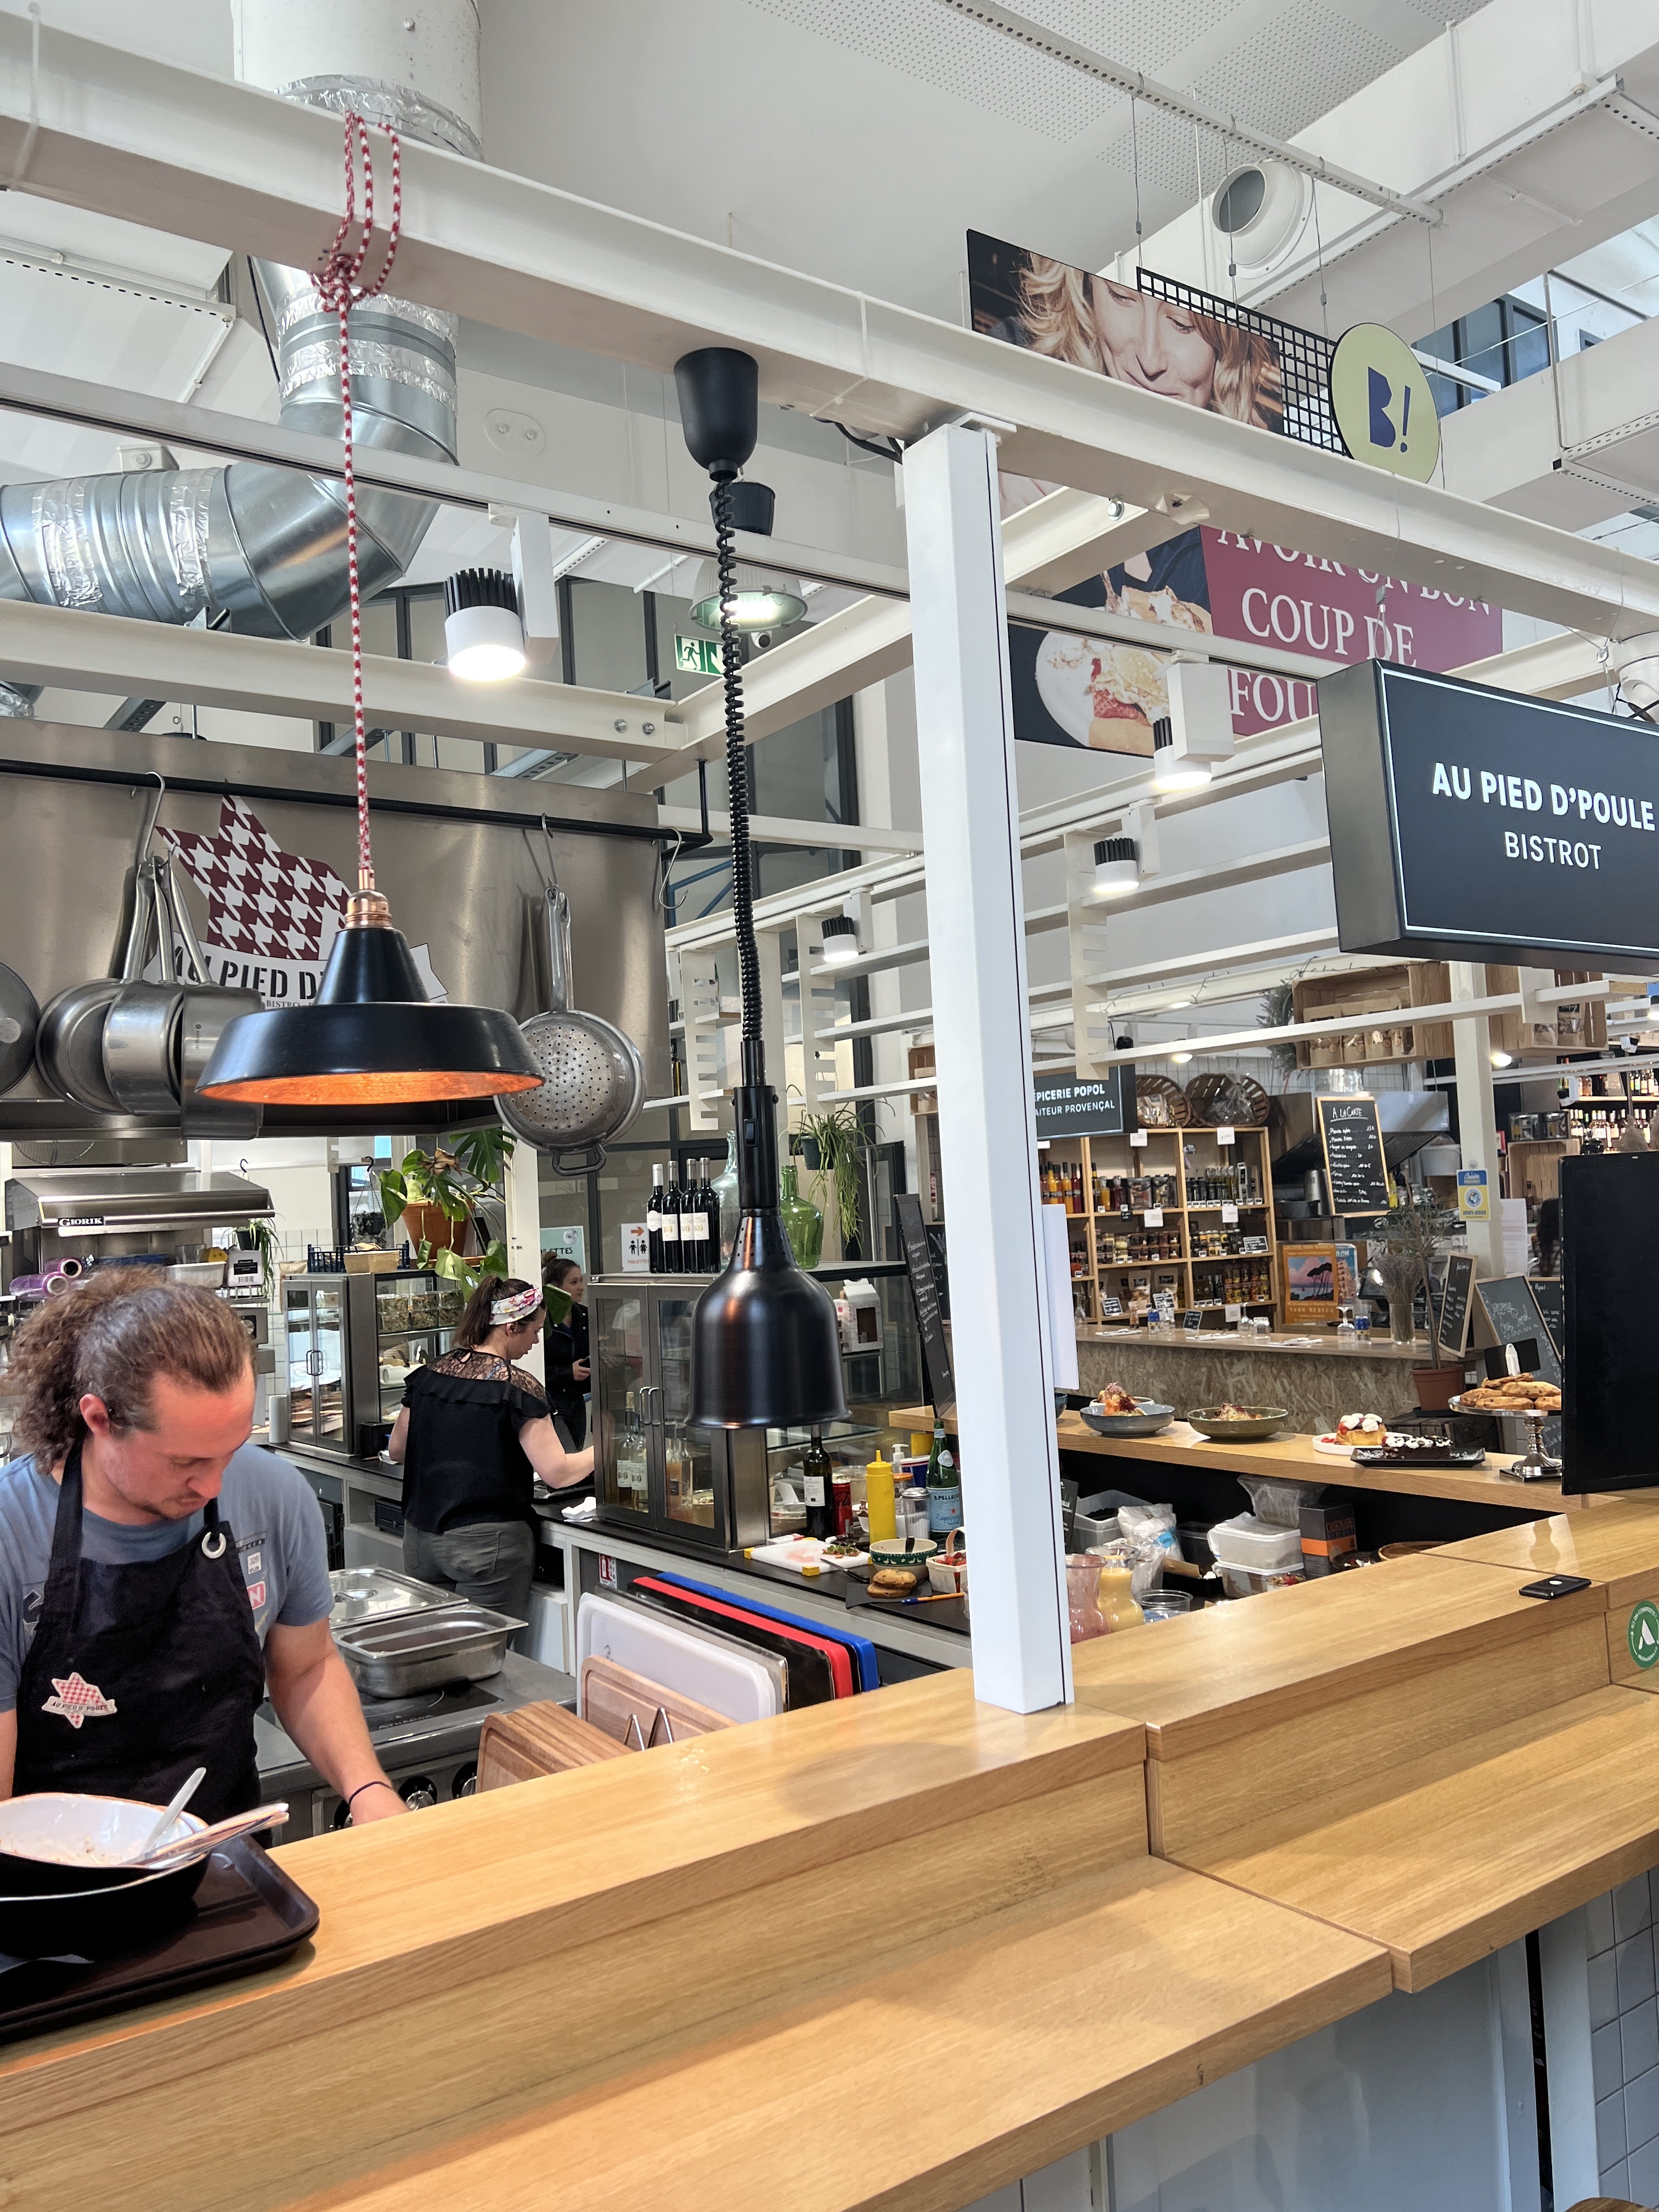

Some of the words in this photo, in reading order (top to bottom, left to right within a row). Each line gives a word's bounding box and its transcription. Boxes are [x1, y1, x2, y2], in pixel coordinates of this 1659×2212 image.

[1368, 366, 1412, 453] B!
[1242, 587, 1355, 656] COUP
[1363, 615, 1417, 668] DE
[1432, 761, 1472, 800] AU
[1481, 770, 1543, 812] PIED
[1550, 783, 1656, 832] D'POULE
[1504, 831, 1602, 870] BISTROT
[219, 960, 288, 998] PIED
[1065, 1099, 1115, 1114] PROVENÇAL
[1074, 1084, 1105, 1098] POPOL
[59, 1218, 103, 1227] GIORIK
